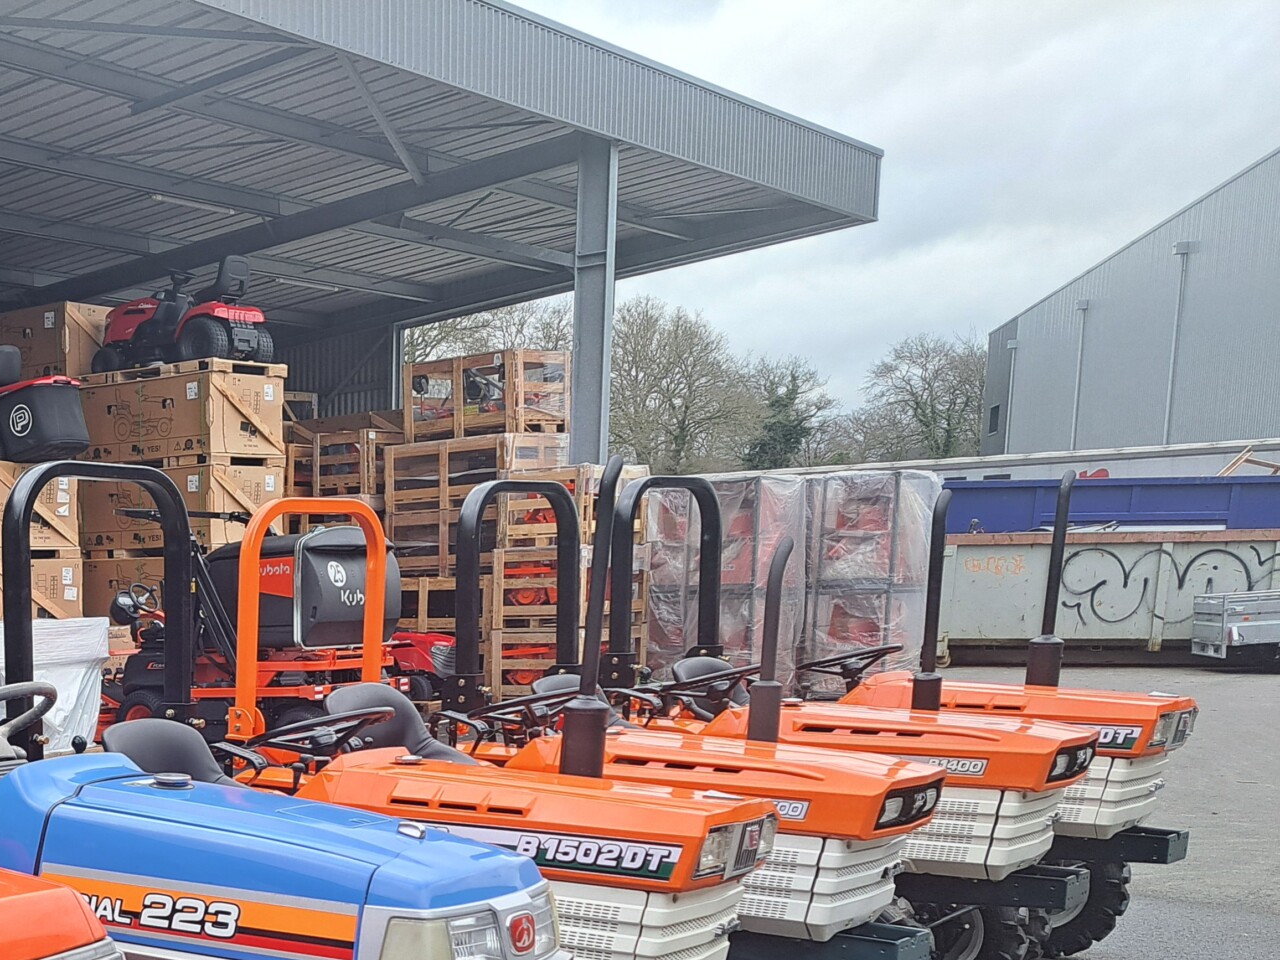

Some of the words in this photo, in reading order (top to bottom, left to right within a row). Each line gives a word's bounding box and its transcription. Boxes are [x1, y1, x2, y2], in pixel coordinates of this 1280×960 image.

[147, 445, 161, 453] YES!
[147, 534, 162, 542] YES!
[260, 563, 291, 576] ubota
[773, 800, 804, 817] 00
[138, 892, 241, 938] 223
